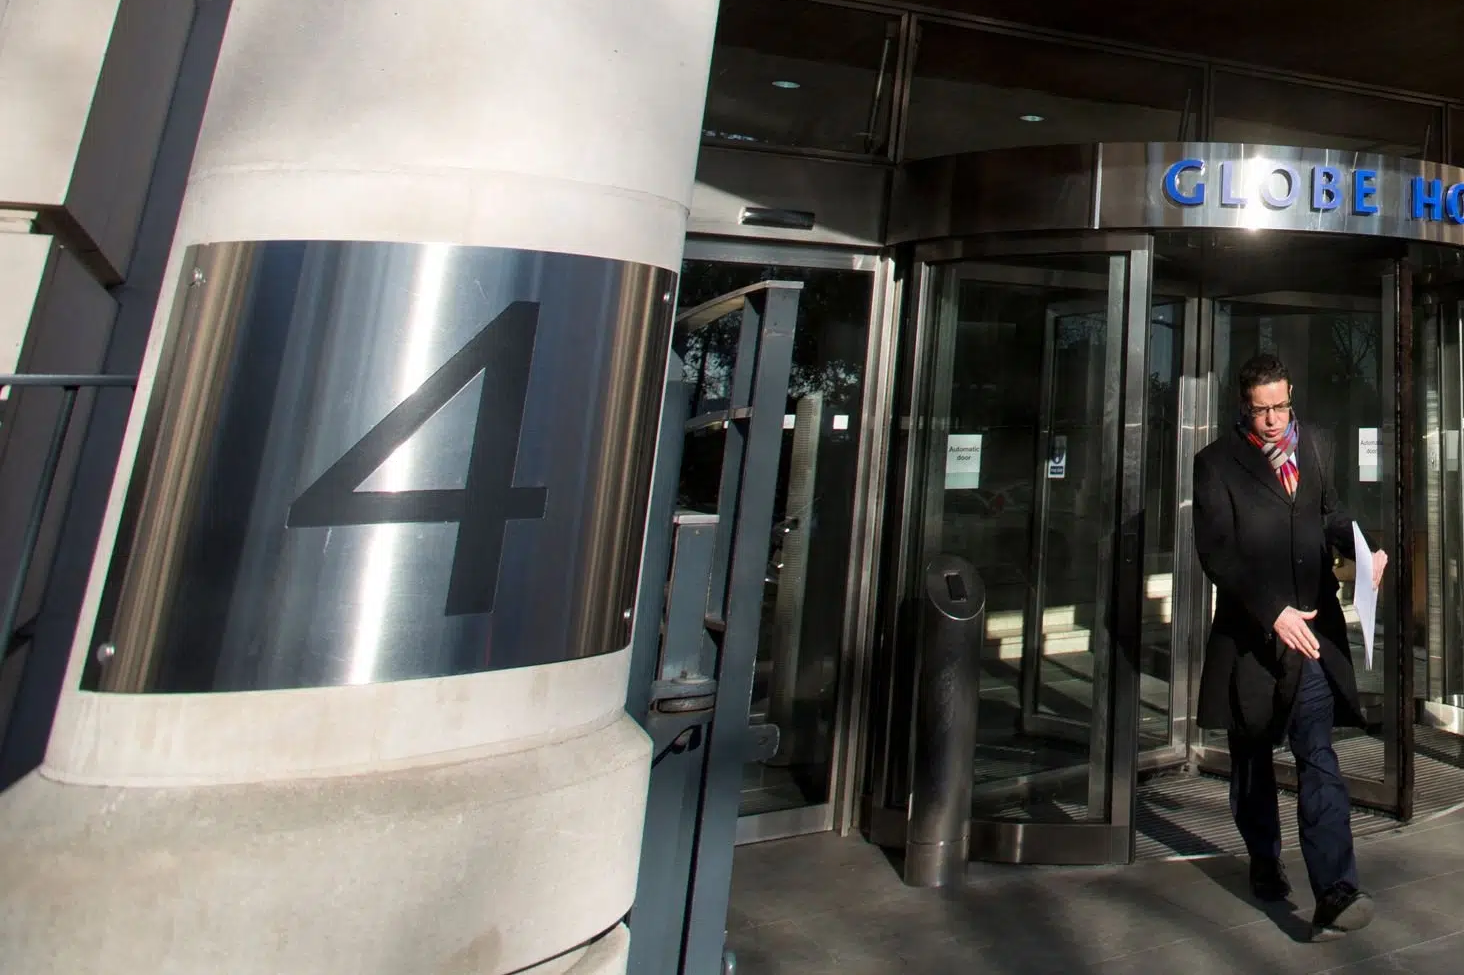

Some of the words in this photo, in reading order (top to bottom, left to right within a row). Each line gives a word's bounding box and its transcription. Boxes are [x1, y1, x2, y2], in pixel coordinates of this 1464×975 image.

[1164, 159, 1379, 216] GLOBE
[286, 301, 548, 617] 4
[949, 445, 980, 453] Automatic
